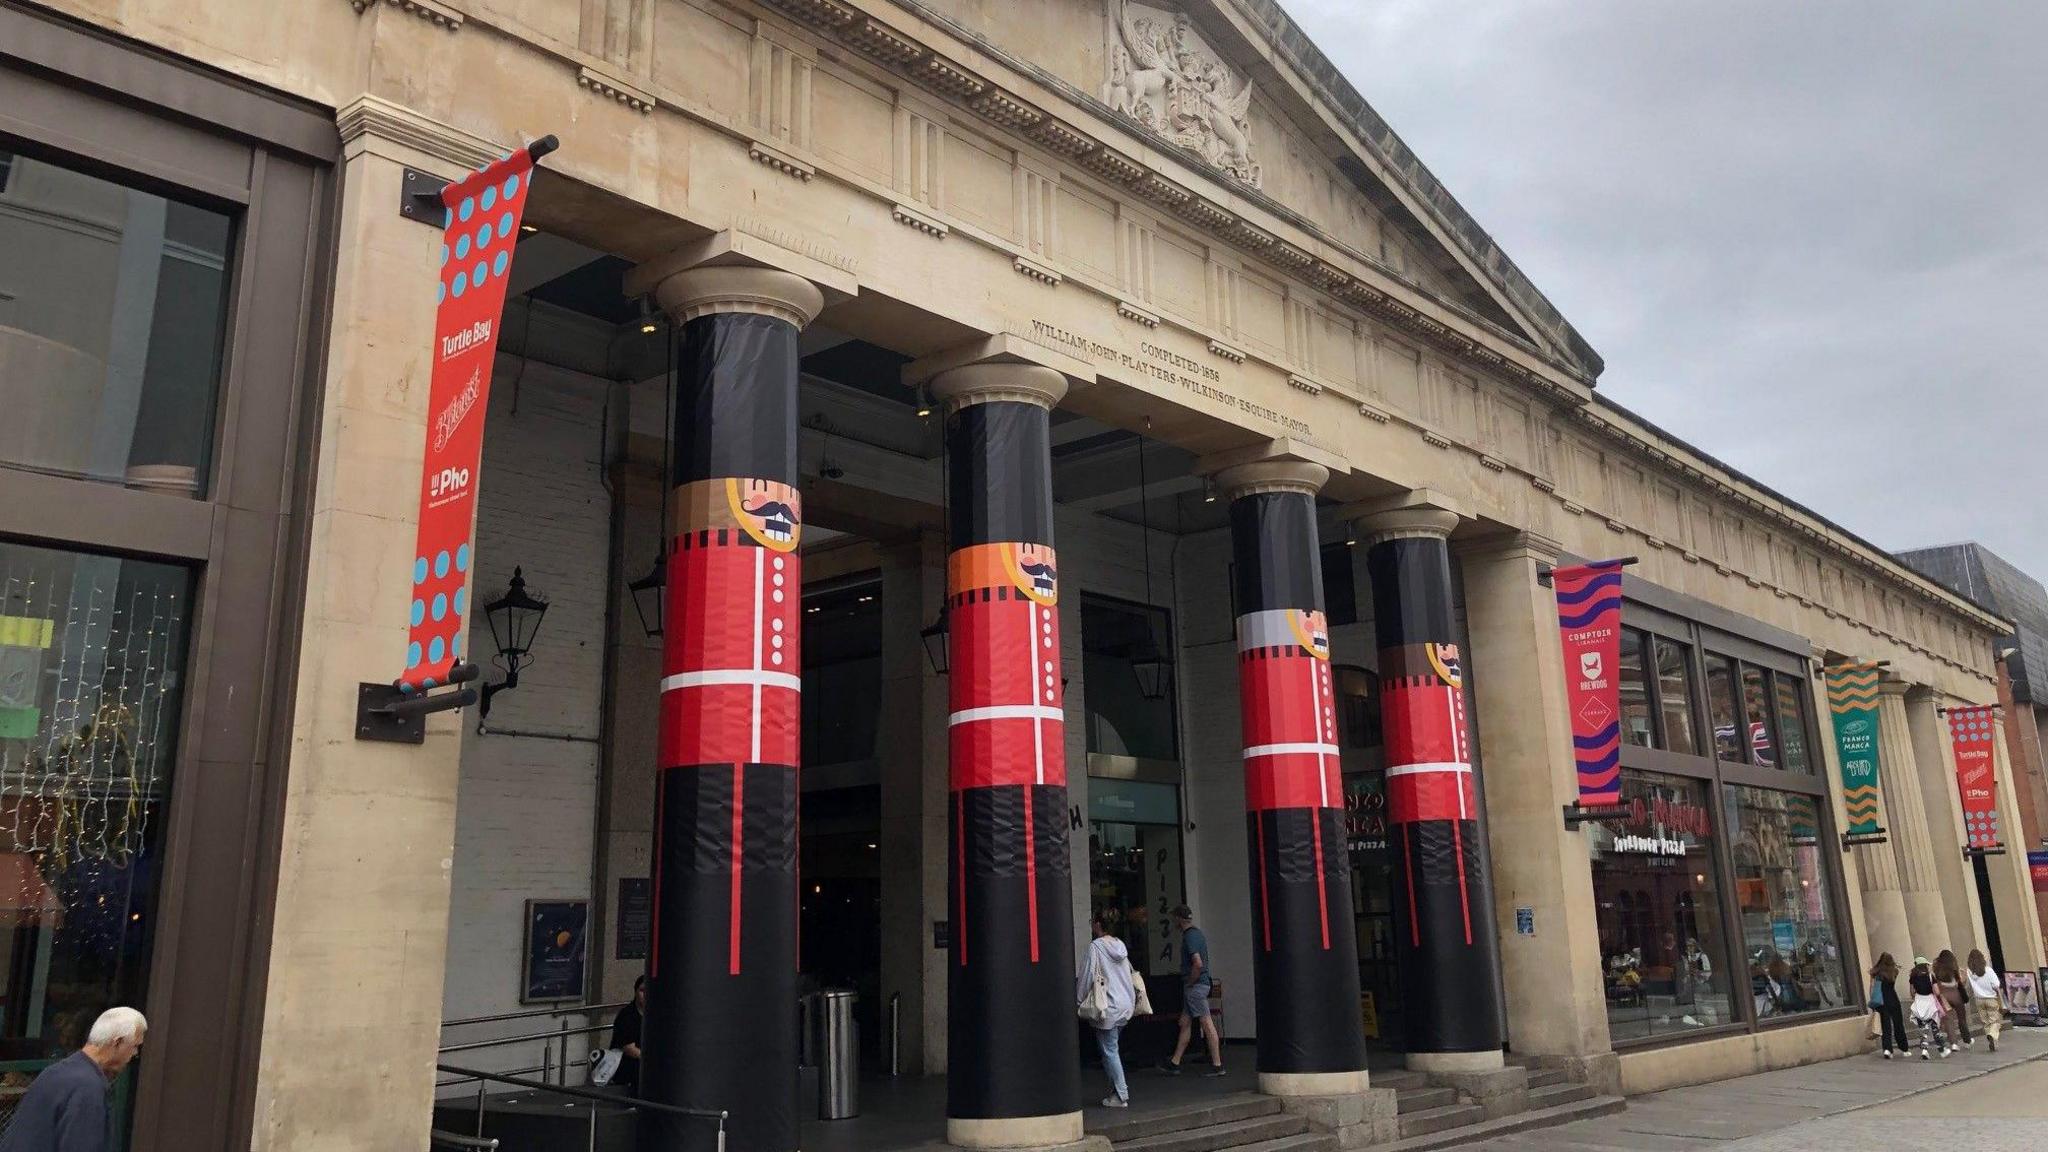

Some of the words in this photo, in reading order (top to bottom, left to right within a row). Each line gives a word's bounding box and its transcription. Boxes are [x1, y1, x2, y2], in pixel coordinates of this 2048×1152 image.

[442, 328, 473, 357] Turtle
[473, 319, 492, 343] Bay
[1141, 342, 1199, 374] COMPLETED
[1032, 319, 1088, 350] WILLIAM
[1090, 342, 1118, 362] JOHN
[1122, 356, 1177, 384] PLAYTERS
[1181, 376, 1238, 407] WILKINSON
[1239, 399, 1279, 423] ESQUIRE
[440, 466, 469, 496] Pho
[1568, 628, 1612, 641] COMPTOIR
[1580, 679, 1608, 691] BREWDOG
[1842, 735, 1871, 743] FRANCO
[1844, 742, 1871, 751] MANCA
[1971, 788, 1989, 797] Pho
[1358, 840, 1386, 851] PIZZA
[1660, 837, 1686, 856] PIZZA
[1156, 848, 1173, 962] PIZZA
